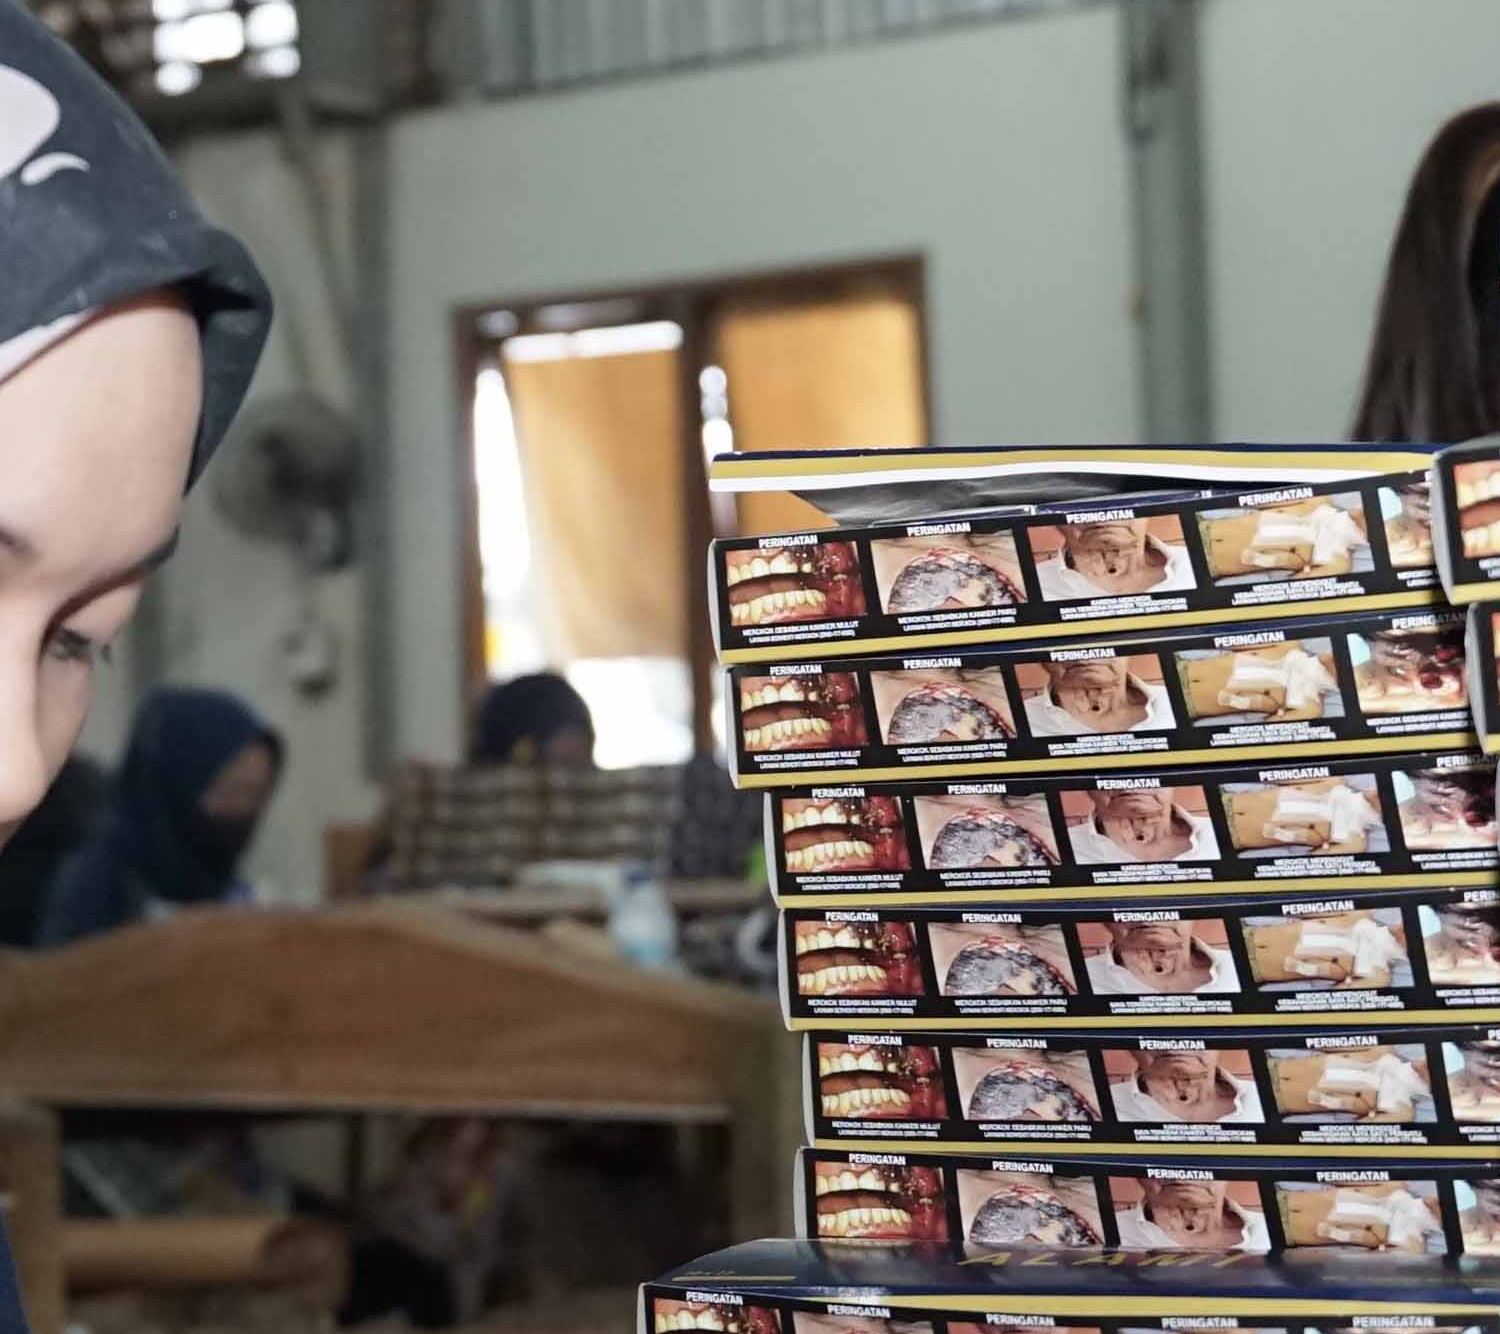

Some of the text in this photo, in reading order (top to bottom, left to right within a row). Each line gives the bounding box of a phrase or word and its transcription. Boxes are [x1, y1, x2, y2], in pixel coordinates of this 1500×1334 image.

[1239, 488, 1312, 506] PERINGATAN
[1067, 509, 1133, 523] PERINGATAN
[908, 523, 970, 536] PERINGATAN
[759, 535, 818, 548] PERINGATAN
[1214, 632, 1284, 647] PERINGATAN
[1050, 648, 1114, 662] PERINGATAN
[904, 657, 961, 669] PERINGATAN
[770, 664, 821, 676] PERINGATAN
[1259, 767, 1328, 781] PERINGATAN
[948, 784, 1006, 795] PERINGATAN
[1097, 778, 1160, 790] PERINGATAN
[812, 788, 864, 798] PERINGATAN
[1282, 900, 1354, 914] PERINGATAN
[825, 912, 879, 923] PERINGATAN
[962, 913, 1021, 924] PERINGATAN
[1114, 911, 1179, 923] PERINGATAN
[848, 1035, 902, 1046] PERINGATAN
[987, 1038, 1047, 1049] PERINGATAN
[1139, 1039, 1205, 1051] PERINGATAN
[1306, 1035, 1377, 1049] PERINGATAN
[849, 1153, 906, 1165] PERINGATAN
[992, 1161, 1053, 1174] PERINGATAN
[1147, 1169, 1213, 1180] PERINGATAN
[1317, 1170, 1389, 1182] PERINGATAN
[686, 1292, 743, 1305] PERINGATAN
[827, 1304, 890, 1318] PERINGATAN
[986, 1313, 1055, 1327] PERINGATAN
[1162, 1317, 1238, 1328] PERINGATAN
[1353, 1316, 1434, 1328] PERINGATAN
